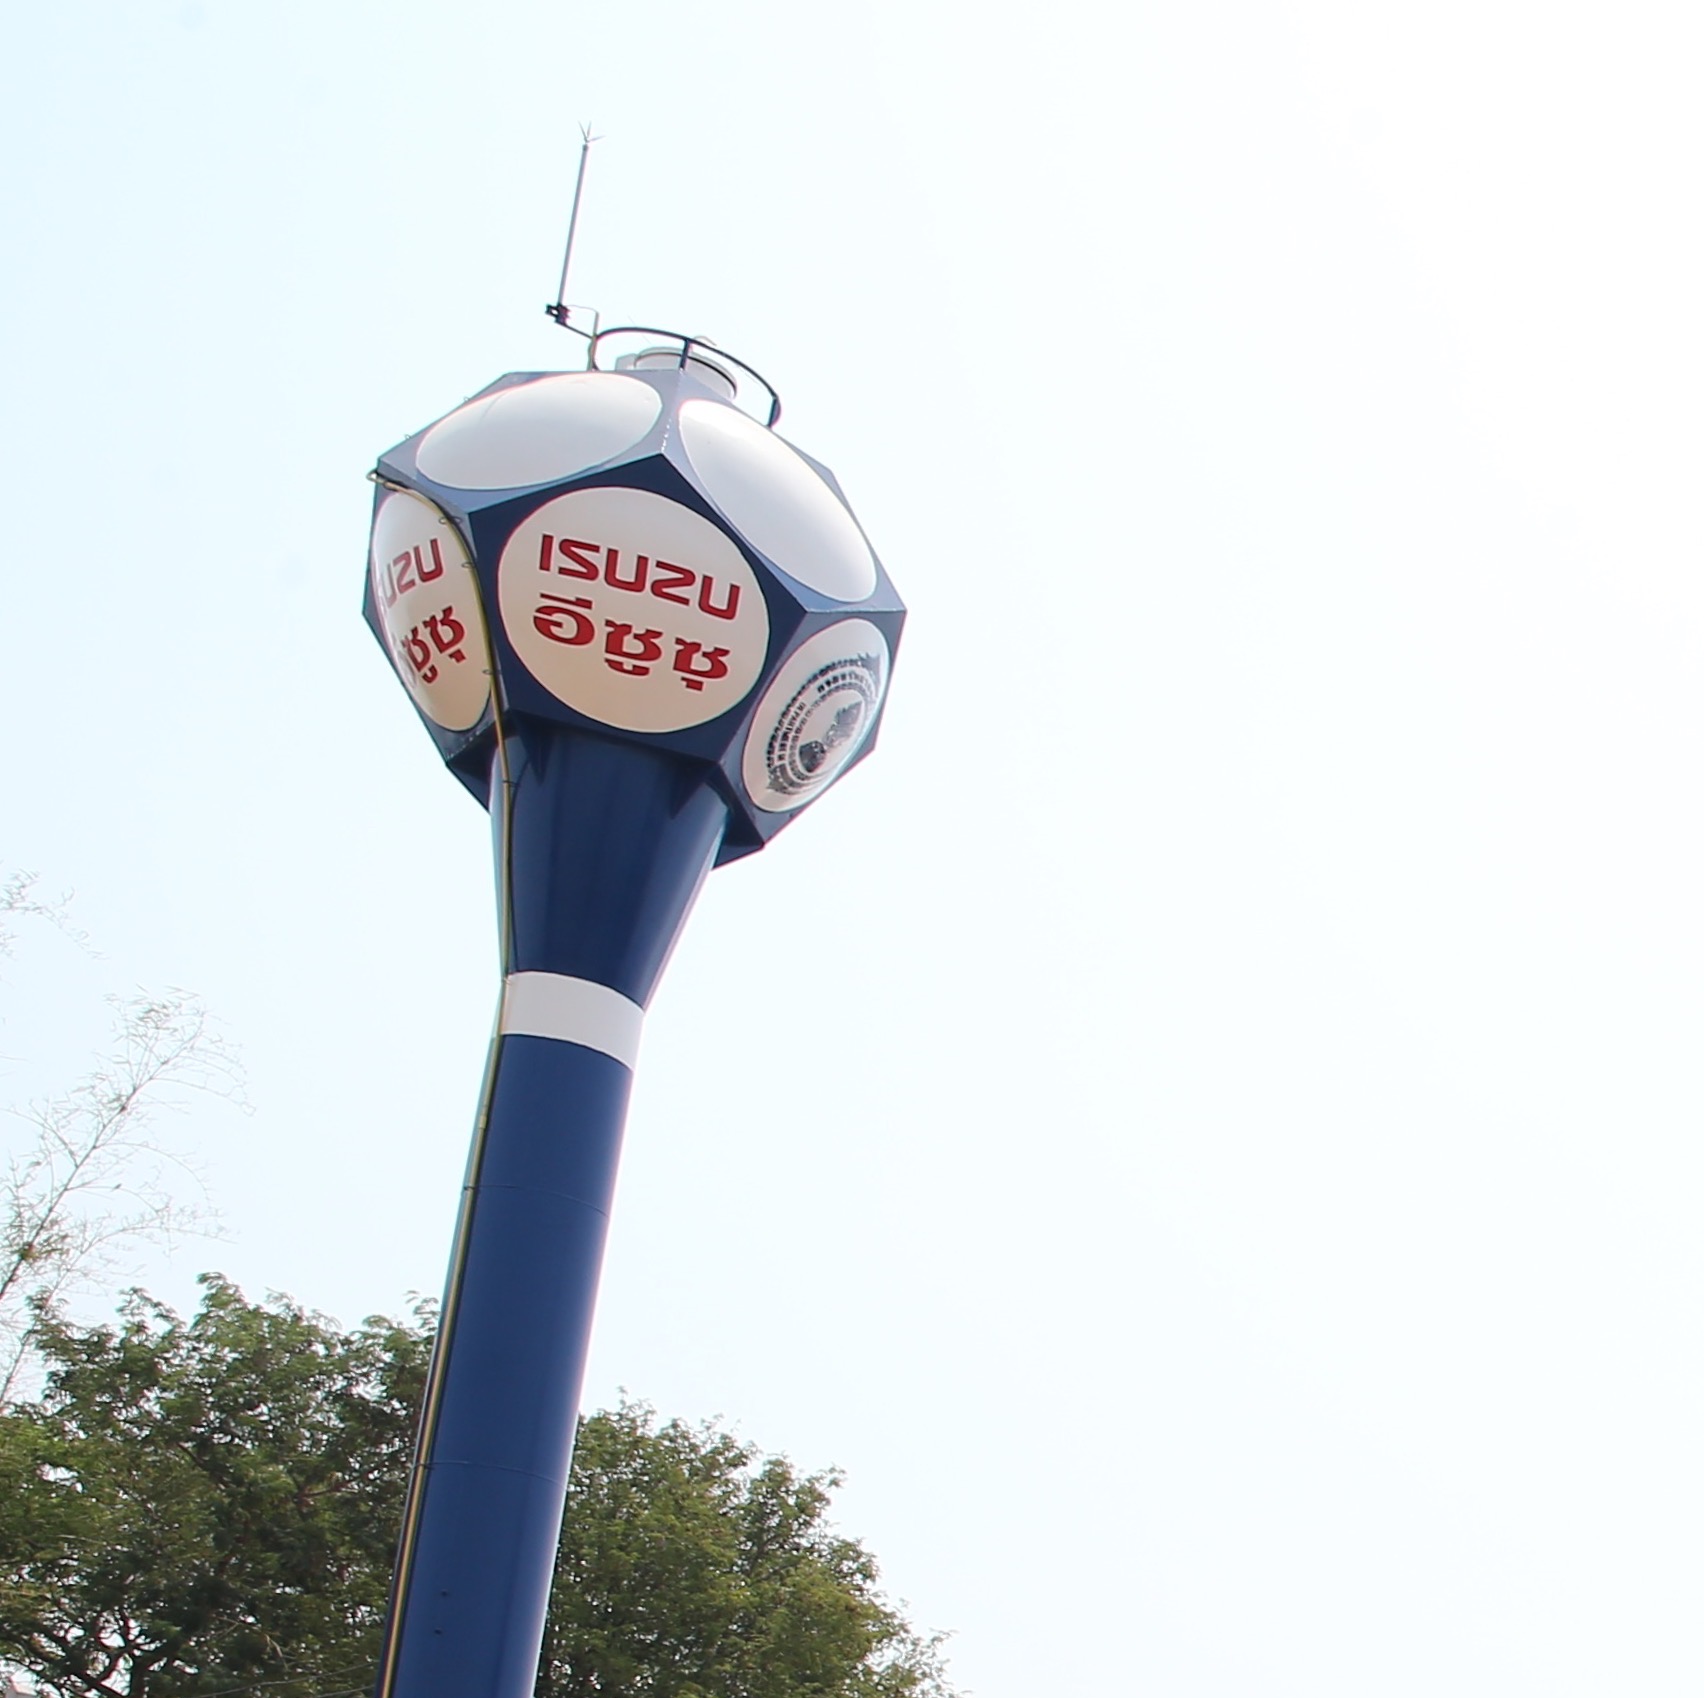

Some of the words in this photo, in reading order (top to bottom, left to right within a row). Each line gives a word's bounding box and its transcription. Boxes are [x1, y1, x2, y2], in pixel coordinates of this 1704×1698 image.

[376, 537, 444, 609] UZU
[538, 533, 741, 621] ISUZU
[533, 592, 730, 692] อีซูซุ
